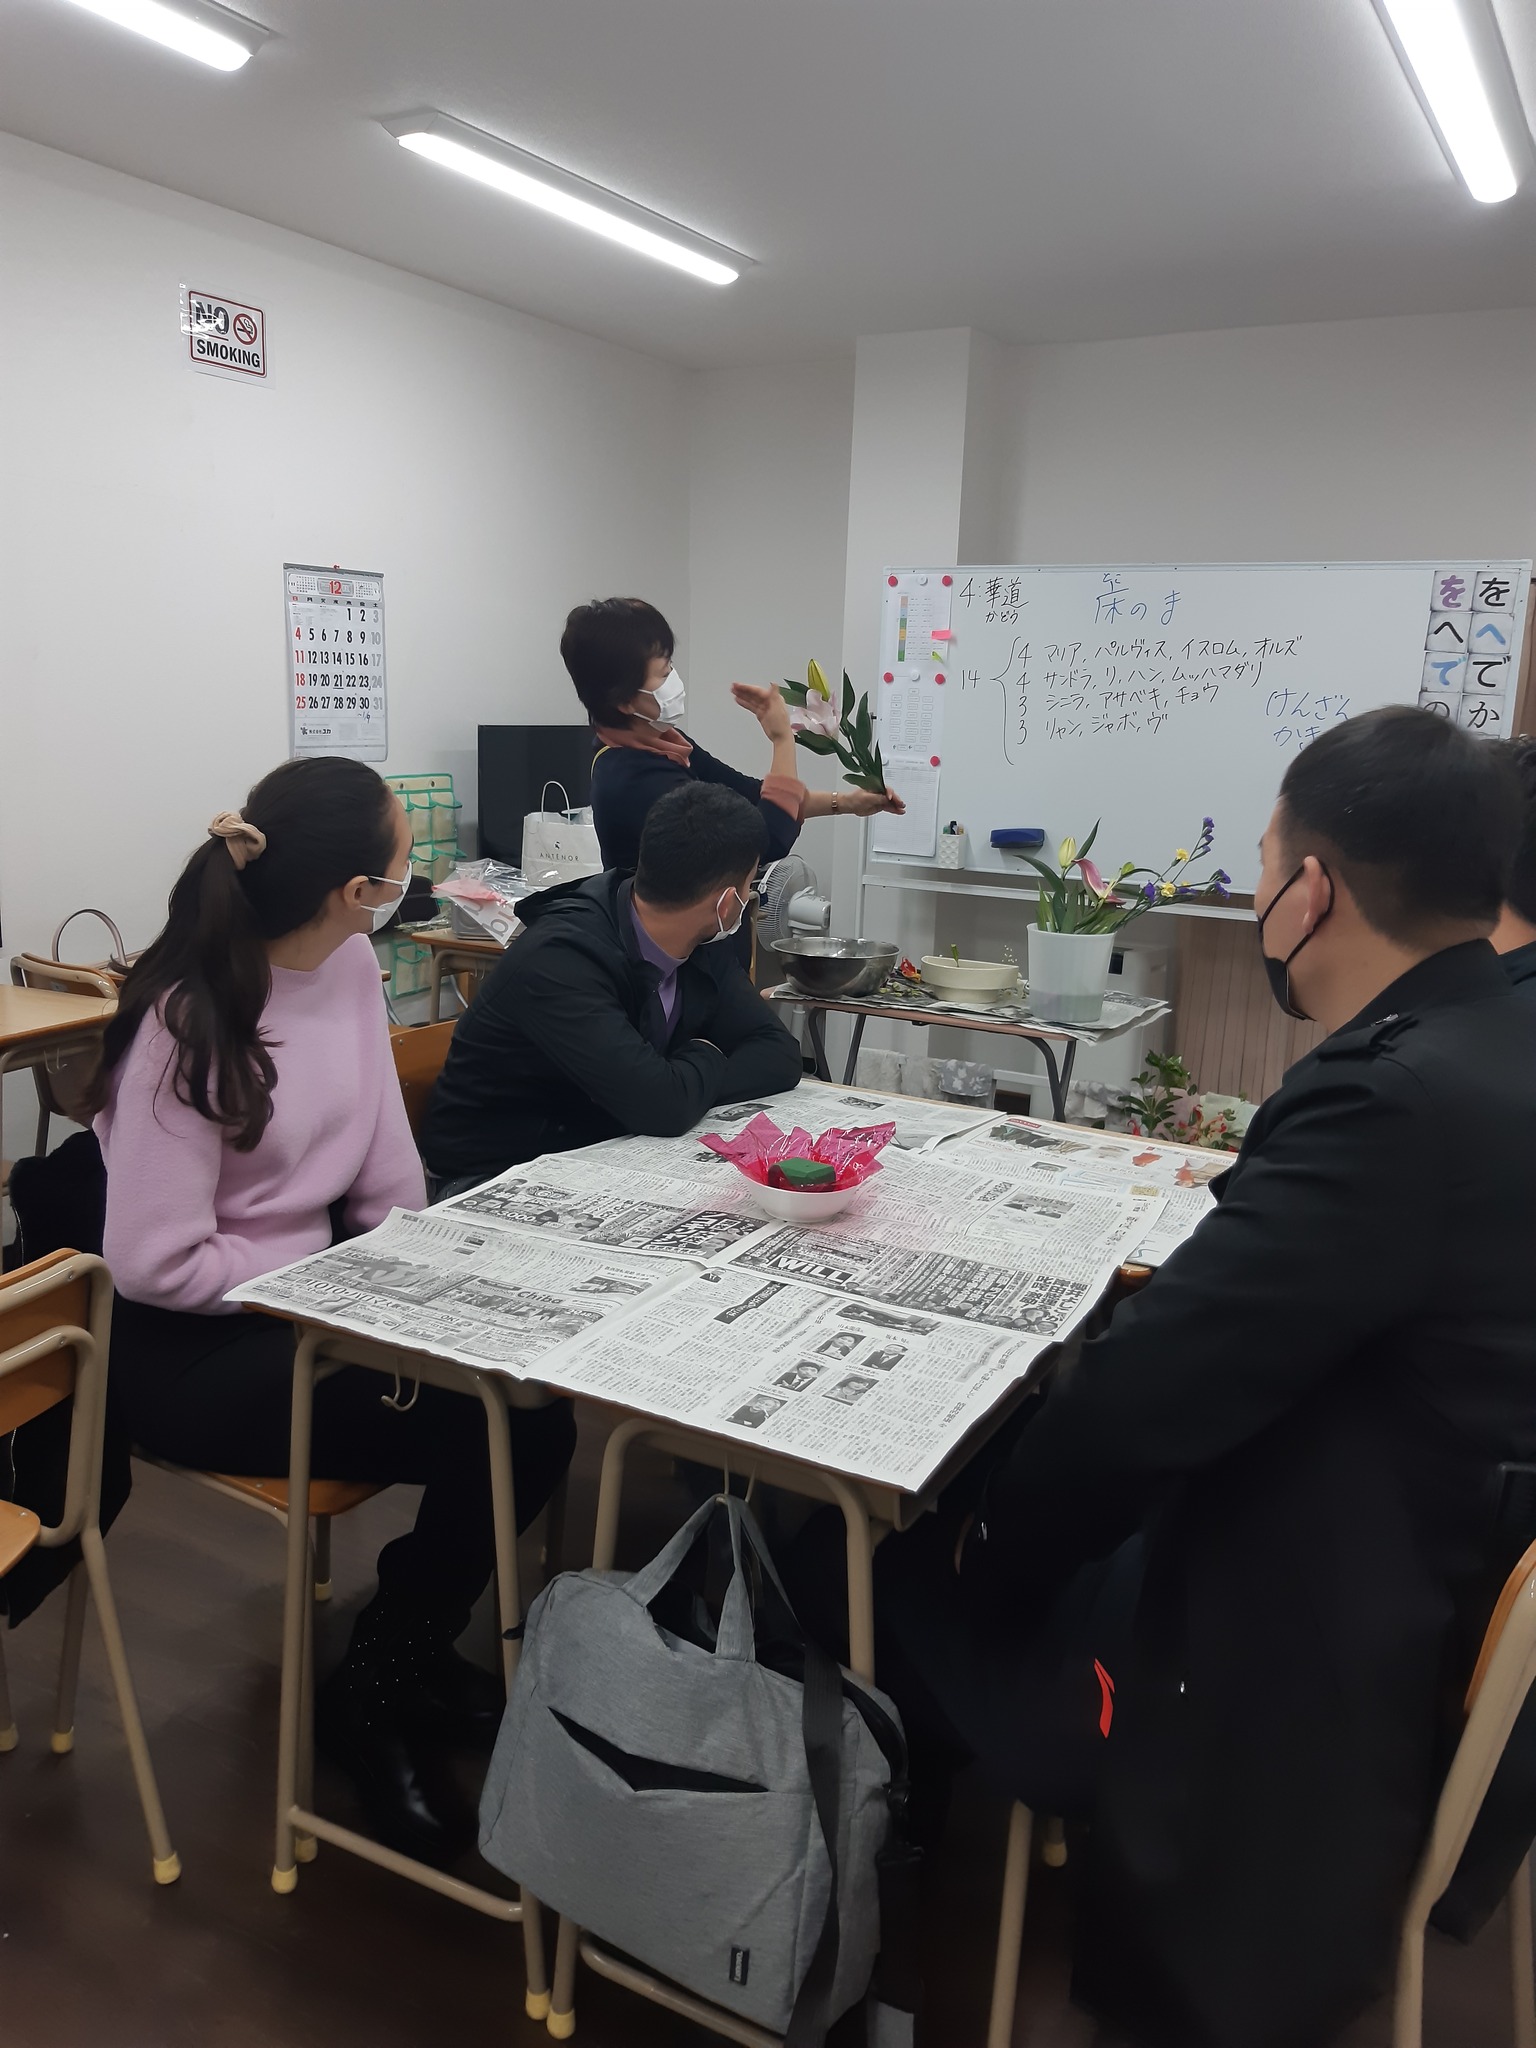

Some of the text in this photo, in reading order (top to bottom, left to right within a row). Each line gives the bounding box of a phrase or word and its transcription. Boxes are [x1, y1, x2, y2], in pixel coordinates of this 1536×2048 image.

[196, 301, 229, 334] NO
[197, 339, 260, 368] SMOKING
[329, 580, 342, 595] 12
[1440, 575, 1510, 608] を を
[347, 608, 352, 621] 1
[360, 609, 366, 622] 2
[373, 610, 379, 623] 3
[295, 627, 381, 645] 4 5 6 7 8 9 10
[1433, 621, 1506, 646] へ へ
[295, 650, 381, 667] 11 12 13 14 15 16 17
[1017, 643, 1033, 668] 4
[1254, 635, 1303, 659] オルズ
[295, 673, 383, 688] 18 19 20 21 22 23 24
[962, 670, 980, 690] 14
[1016, 672, 1031, 693] 4
[1431, 655, 1511, 688] で で
[296, 696, 383, 710] 25 26 27 28 29 30 31
[1019, 696, 1027, 717] 3
[1175, 682, 1219, 705] チョウ
[1266, 689, 1350, 721] けんざん
[1423, 701, 1500, 729] の か
[1017, 720, 1027, 745] 3
[1147, 712, 1168, 734] ヴ
[540, 852, 579, 862] ANTENOR
[777, 1257, 844, 1283] WiLL
[517, 1290, 564, 1304] Chiba
